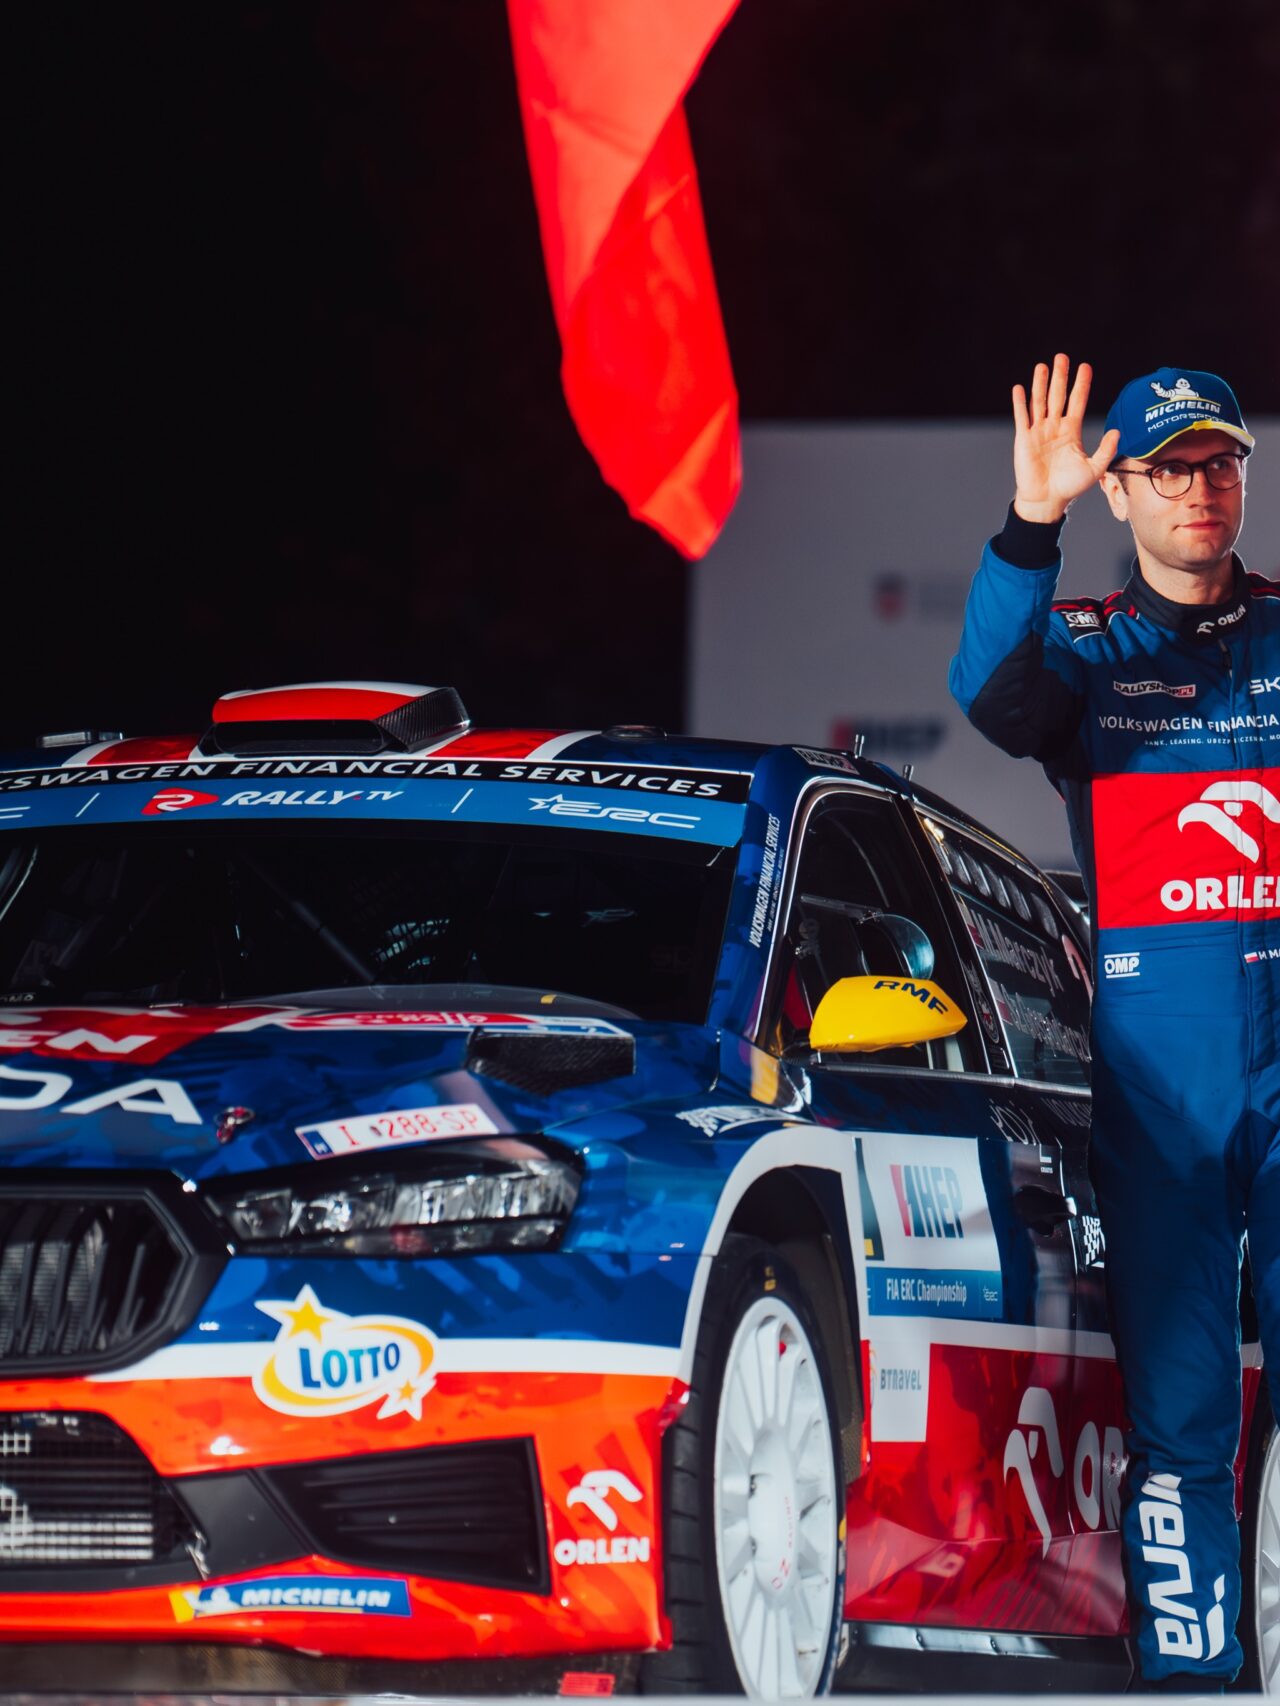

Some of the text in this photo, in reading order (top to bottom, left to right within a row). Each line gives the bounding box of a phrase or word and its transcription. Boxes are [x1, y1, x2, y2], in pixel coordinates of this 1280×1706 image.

[1145, 401, 1221, 422] MICHELIN
[1099, 716, 1202, 733] VOLKSWAGEN
[230, 761, 482, 777] FINANCIAL
[499, 765, 722, 797] SERVICES
[1104, 957, 1140, 974] OMP
[874, 980, 949, 1015] RMF
[886, 1278, 899, 1300] FIA
[900, 1278, 916, 1301] ERC
[917, 1279, 967, 1308] Championship
[298, 1342, 401, 1389] LOTTO
[553, 1536, 650, 1566] ORLEN
[241, 1586, 392, 1608] MICHELIN
